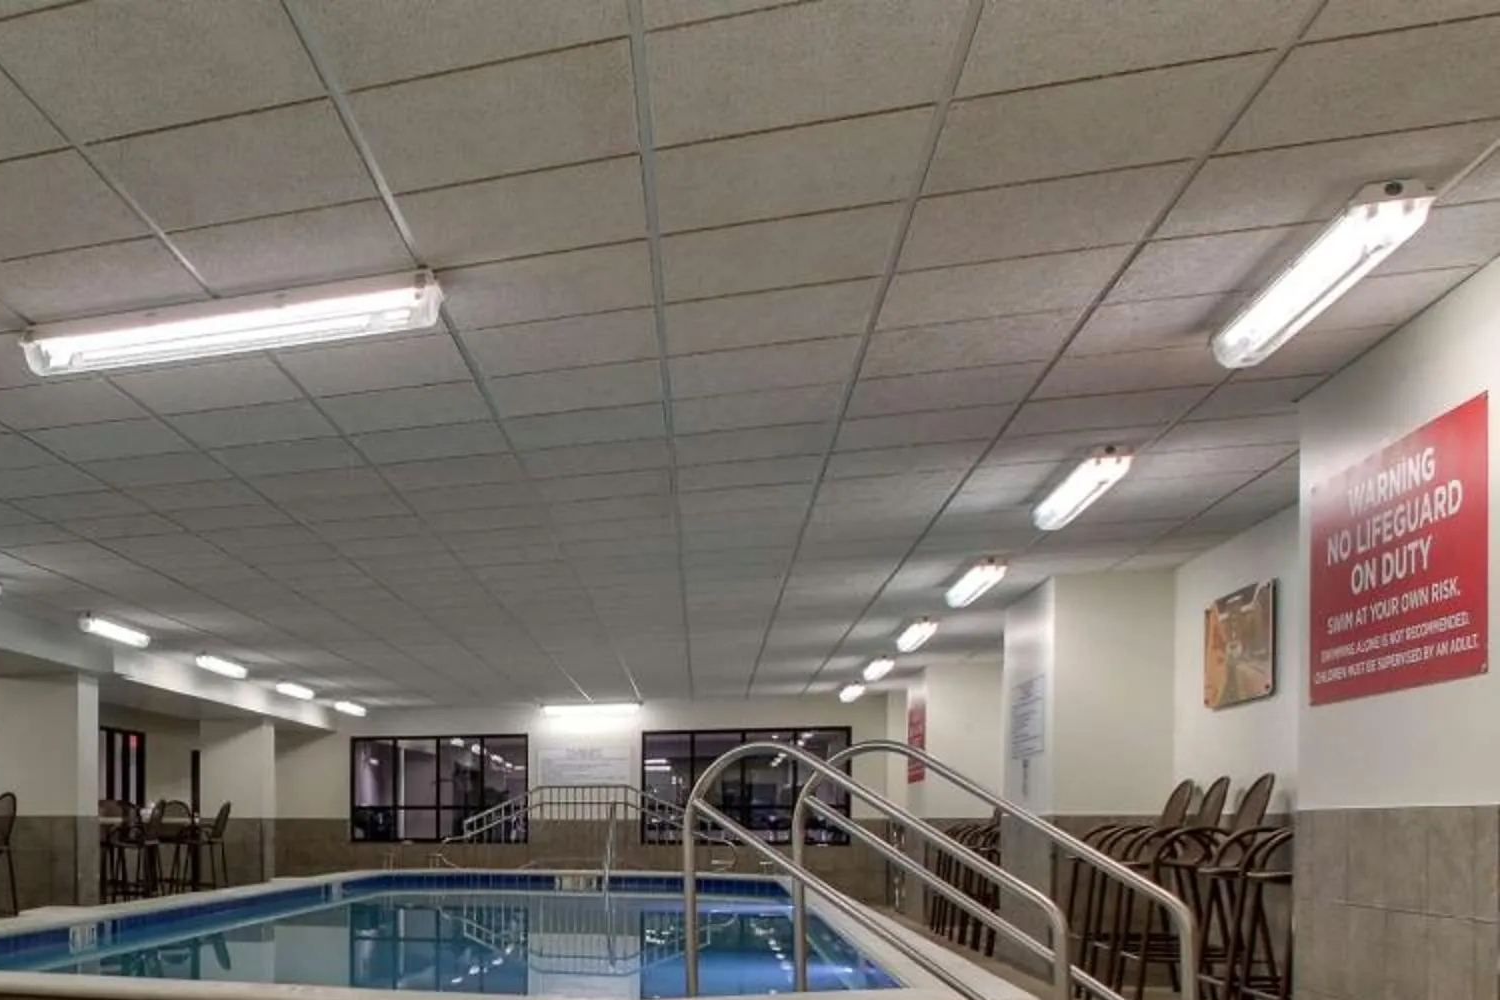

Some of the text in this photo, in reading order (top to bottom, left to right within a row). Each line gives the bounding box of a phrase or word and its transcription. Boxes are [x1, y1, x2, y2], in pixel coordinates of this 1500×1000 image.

[1348, 447, 1435, 517] WARNING
[1327, 479, 1463, 567] NO LIFEGUARD
[1351, 534, 1432, 595] ON DUTY
[1327, 576, 1461, 635] SWIM AT YOUR OWN RISK.
